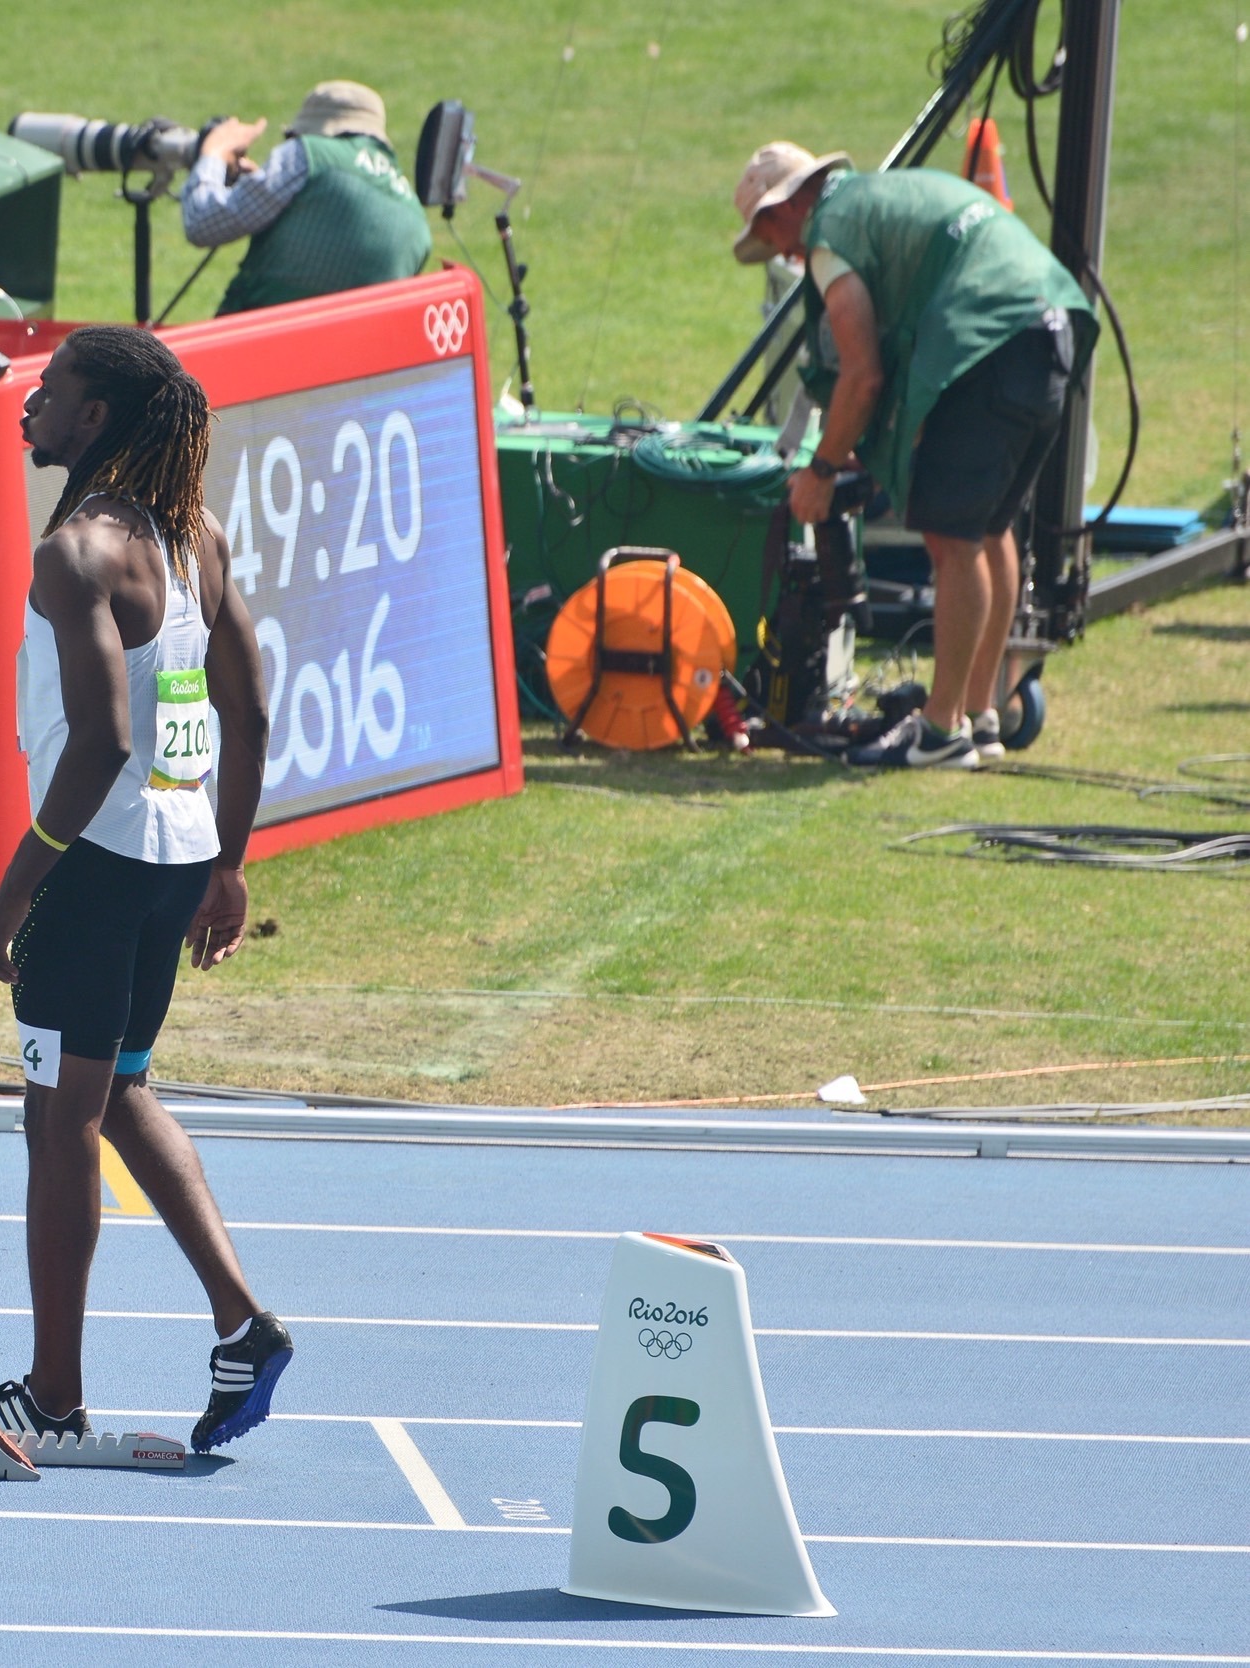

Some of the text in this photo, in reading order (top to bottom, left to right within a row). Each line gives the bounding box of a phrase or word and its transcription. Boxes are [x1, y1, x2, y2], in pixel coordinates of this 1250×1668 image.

[224, 410, 423, 595] 49:20
[171, 680, 199, 695] Rio2016
[254, 592, 405, 789] 2016
[23, 1038, 43, 1072] 4
[628, 1297, 709, 1327] Rio2016
[147, 1452, 179, 1460] OMEGA
[607, 1395, 701, 1545] 5
